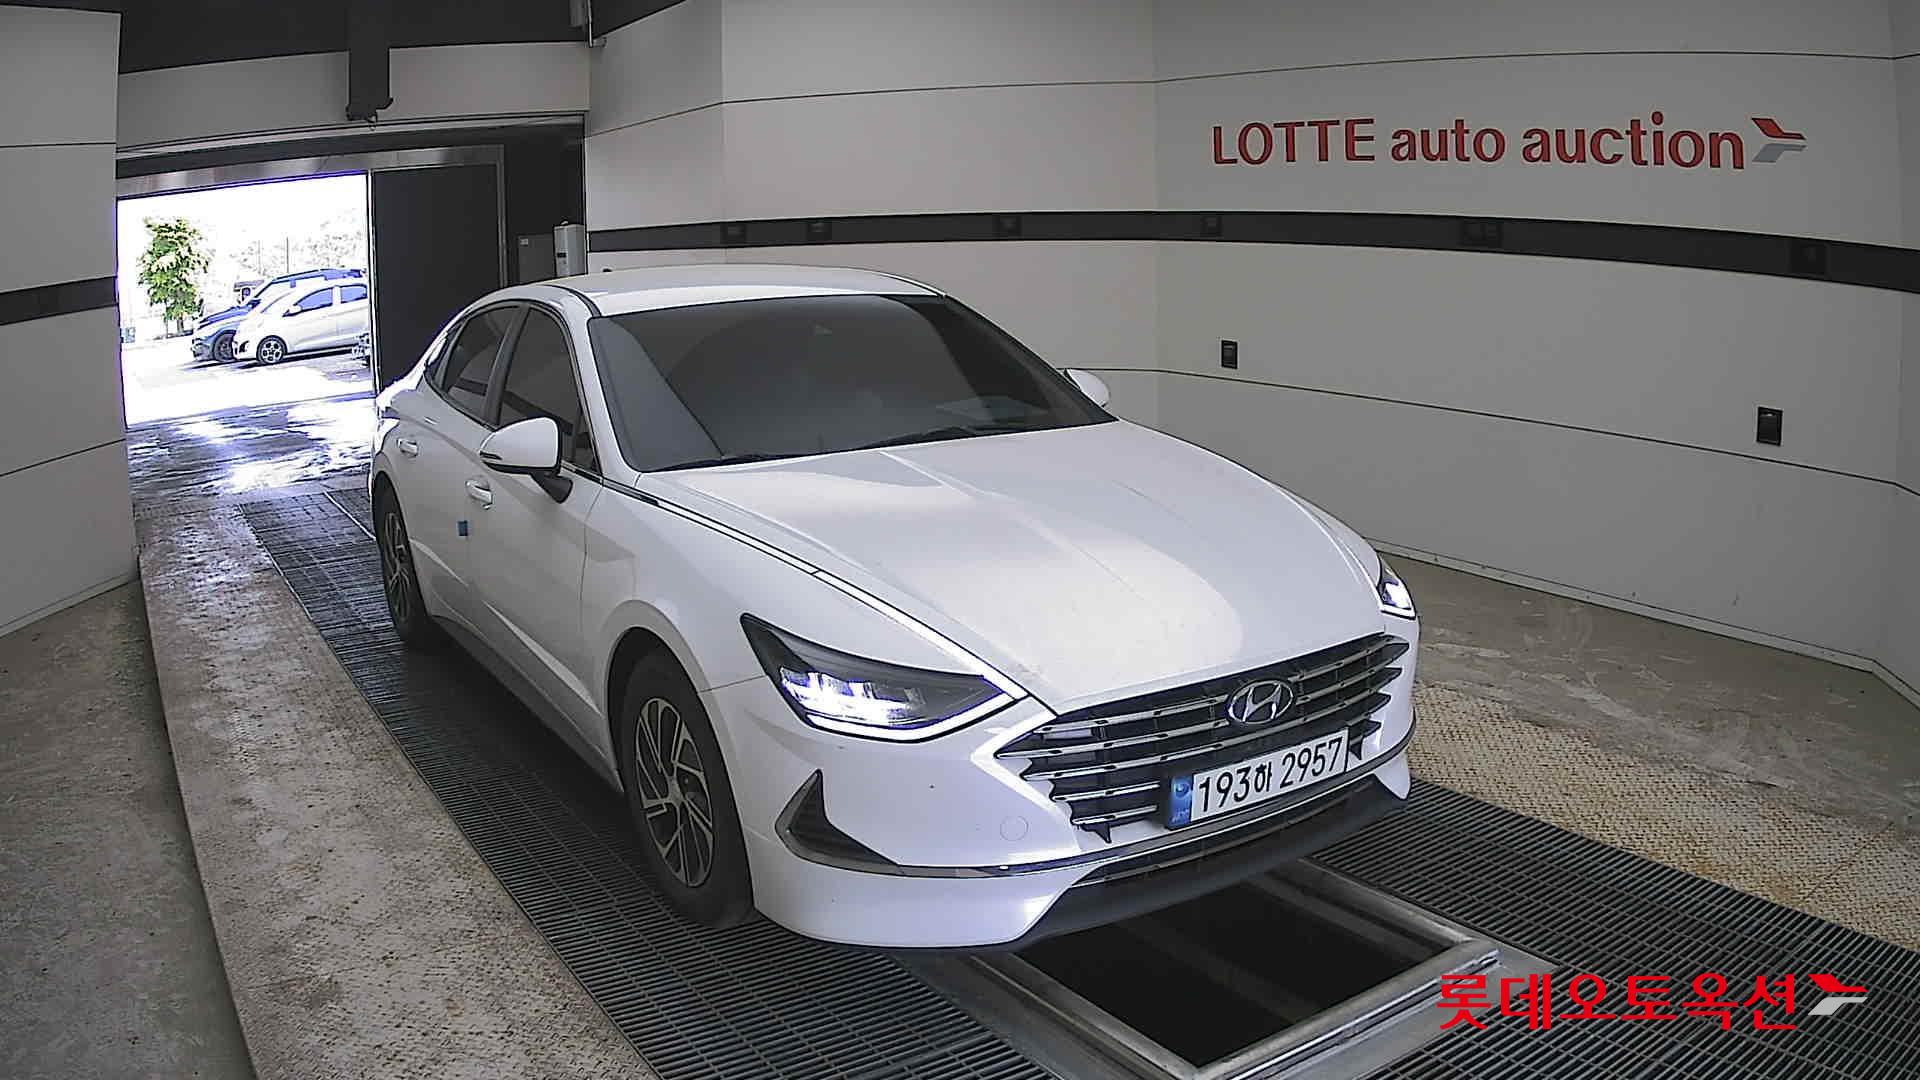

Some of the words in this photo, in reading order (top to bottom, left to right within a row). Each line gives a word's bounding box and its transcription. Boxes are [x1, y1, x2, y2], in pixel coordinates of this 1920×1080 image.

[1213, 118, 1375, 165] LOTTE
[1391, 118, 1506, 163] auto
[1521, 111, 1745, 170] auction
[1199, 762, 1273, 812] 193하
[1279, 737, 1343, 788] 2957
